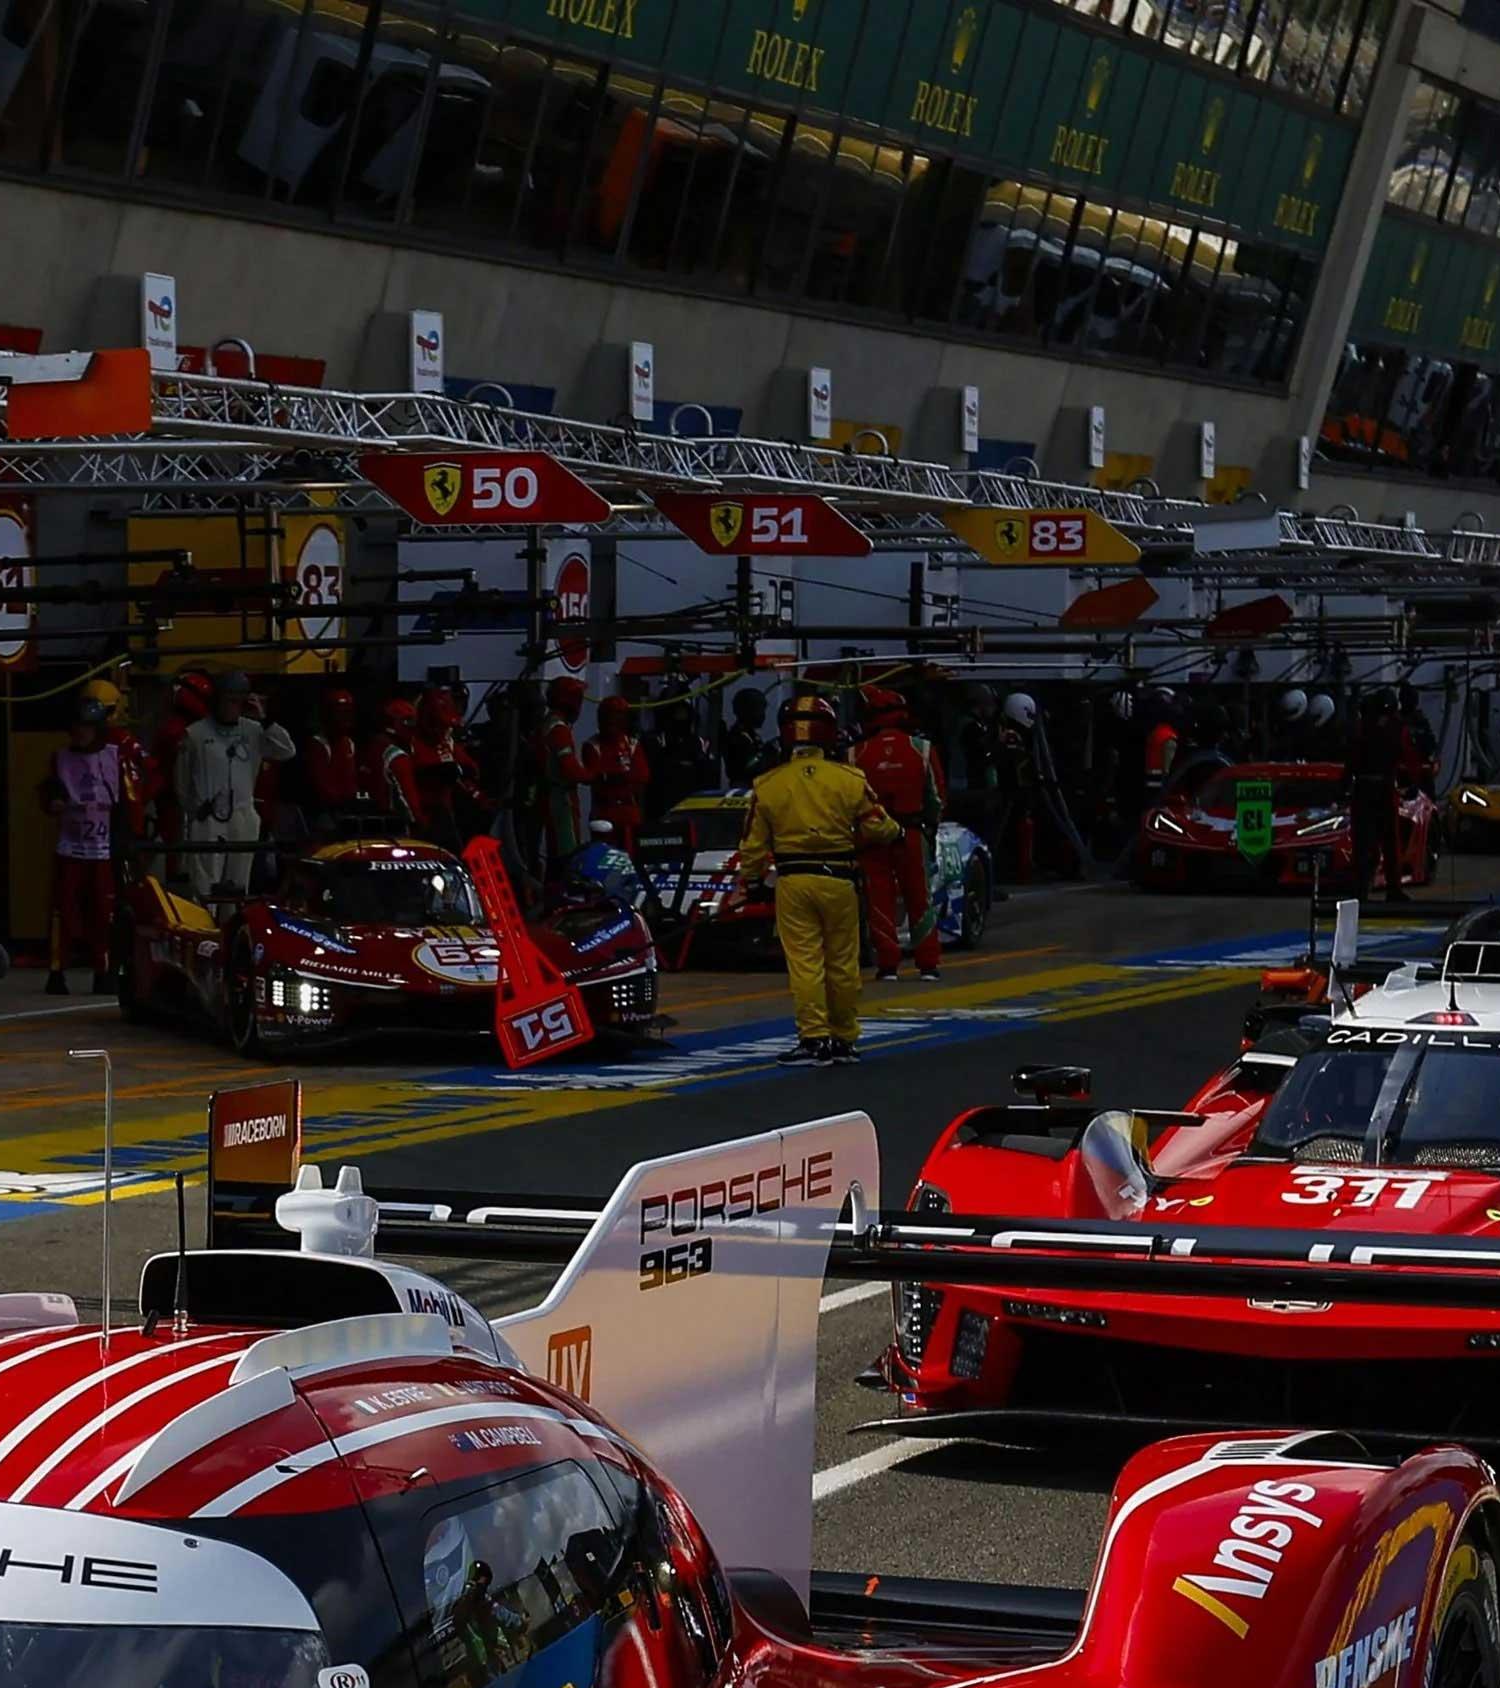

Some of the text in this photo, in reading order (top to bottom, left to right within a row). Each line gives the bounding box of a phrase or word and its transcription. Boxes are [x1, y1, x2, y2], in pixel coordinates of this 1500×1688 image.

[746, 29, 824, 93] ROLEX
[910, 80, 978, 137] ROLEX
[1050, 124, 1109, 176] ROLEX
[1169, 161, 1222, 208] ROLEX
[472, 467, 539, 510] 50
[751, 507, 808, 545] 51
[1030, 518, 1084, 552] 83
[298, 565, 341, 607] 83
[511, 1000, 575, 1051] 51
[233, 1112, 288, 1148] RACEBORN
[639, 1152, 834, 1246] PORSCHE
[1280, 1174, 1435, 1210] 311
[639, 1236, 713, 1292] 963
[407, 1288, 451, 1326] Mobil
[466, 1426, 543, 1450] M.CAMPBELL
[1172, 1476, 1327, 1640] Ansys
